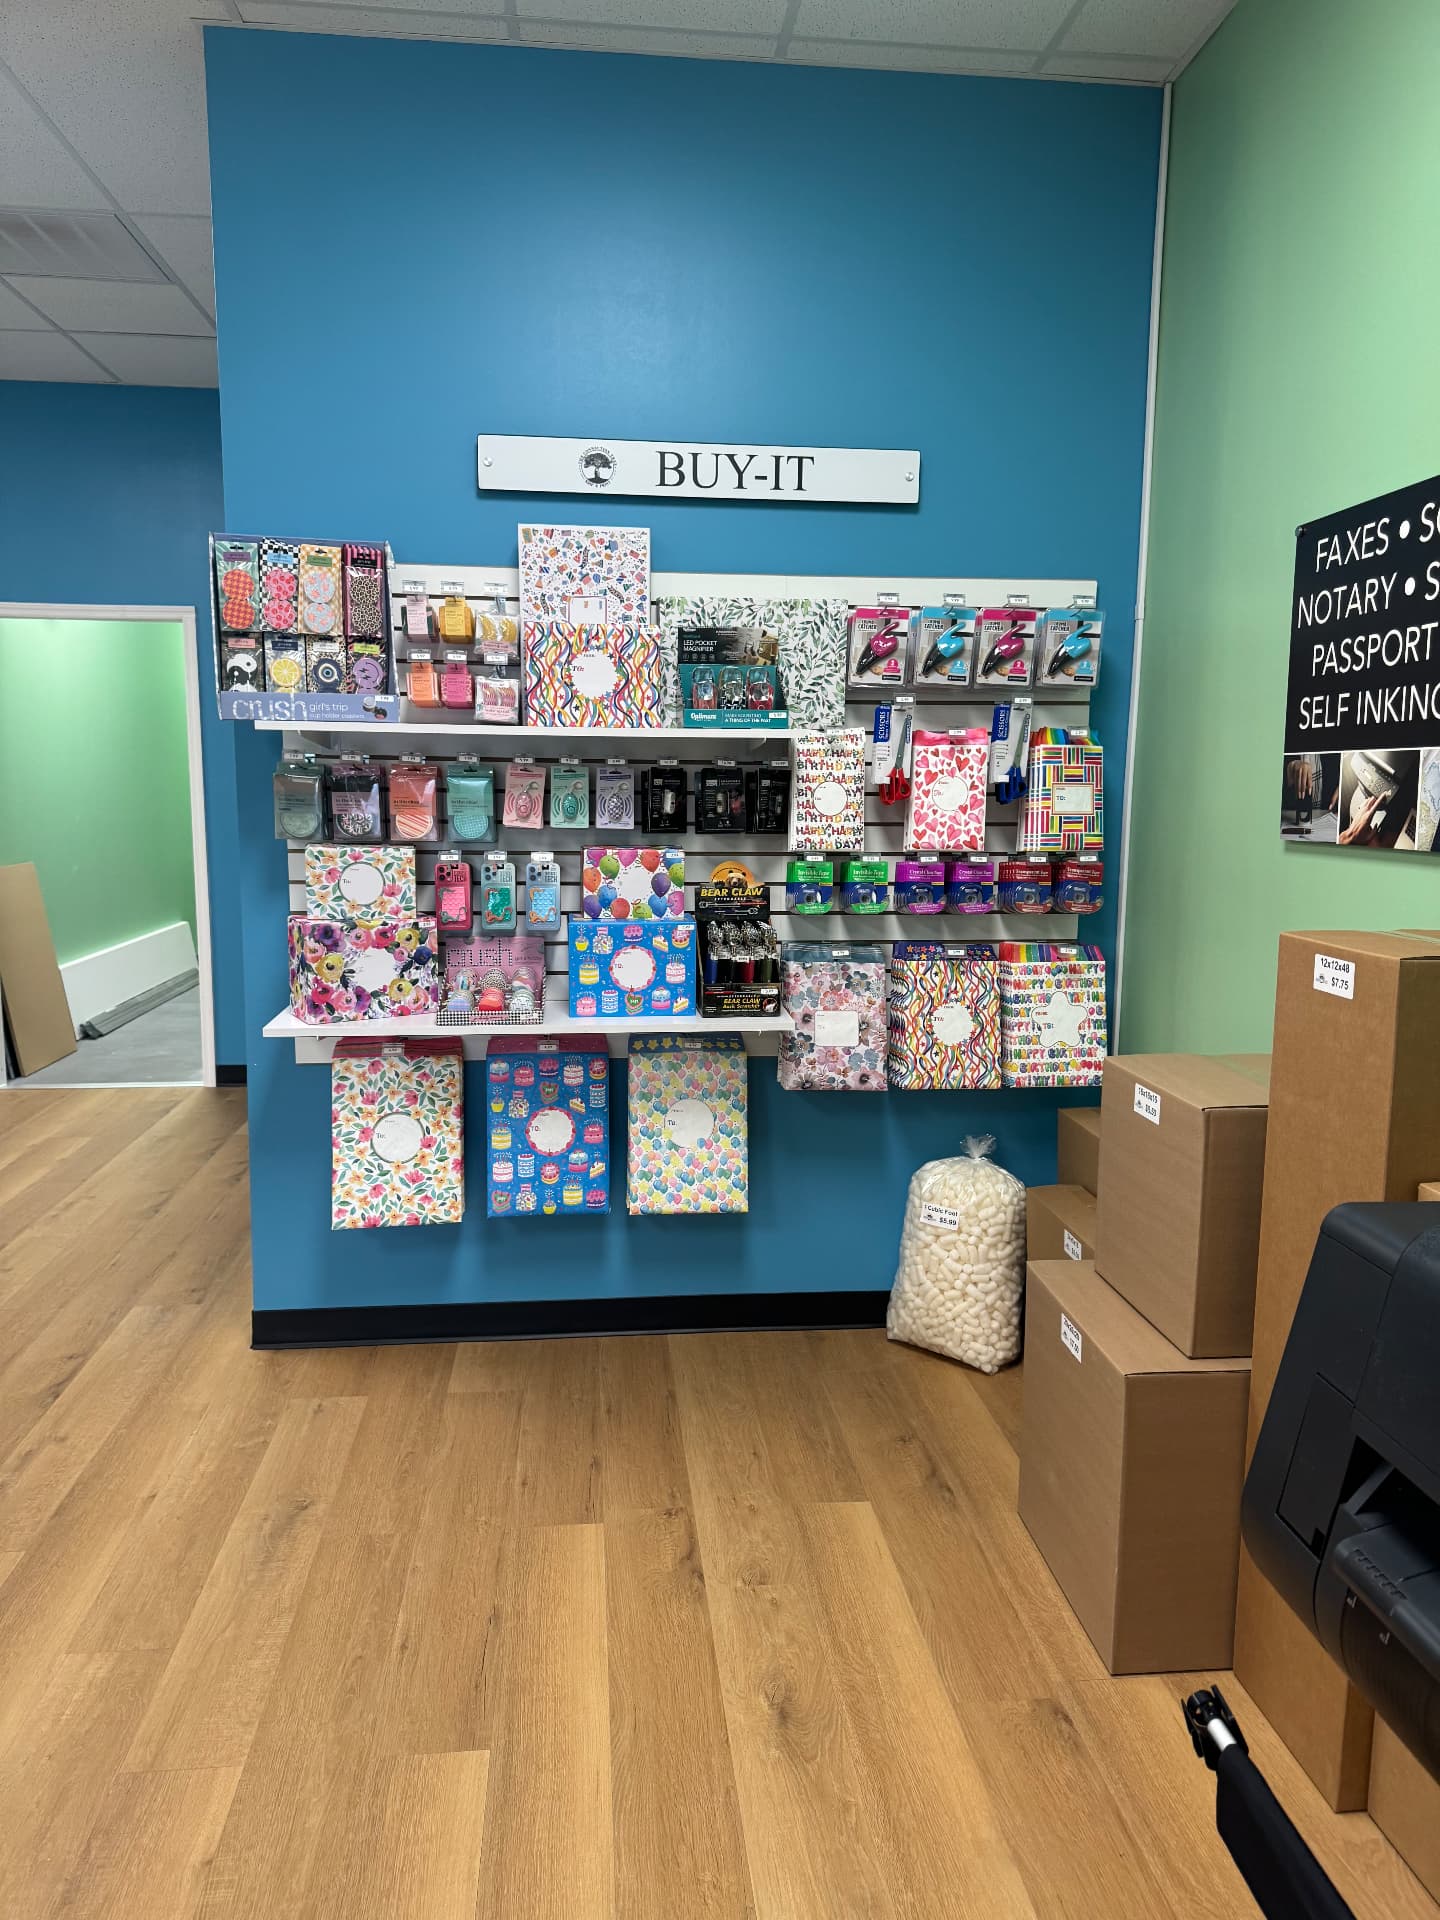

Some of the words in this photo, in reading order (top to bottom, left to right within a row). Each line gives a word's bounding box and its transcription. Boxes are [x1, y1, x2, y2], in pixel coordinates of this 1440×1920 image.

[656, 451, 815, 492] BUY-IT
[1315, 517, 1390, 573] FAXES
[1297, 571, 1397, 629] NOTARY
[1312, 621, 1439, 677] PASSPORT
[232, 692, 308, 721] crush
[332, 703, 348, 712] trip
[1299, 692, 1351, 730] SELF
[701, 888, 729, 897] BEAR
[731, 887, 763, 896] CLAW
[1321, 957, 1350, 973] 12x12x48
[1331, 976, 1349, 990] $7.75
